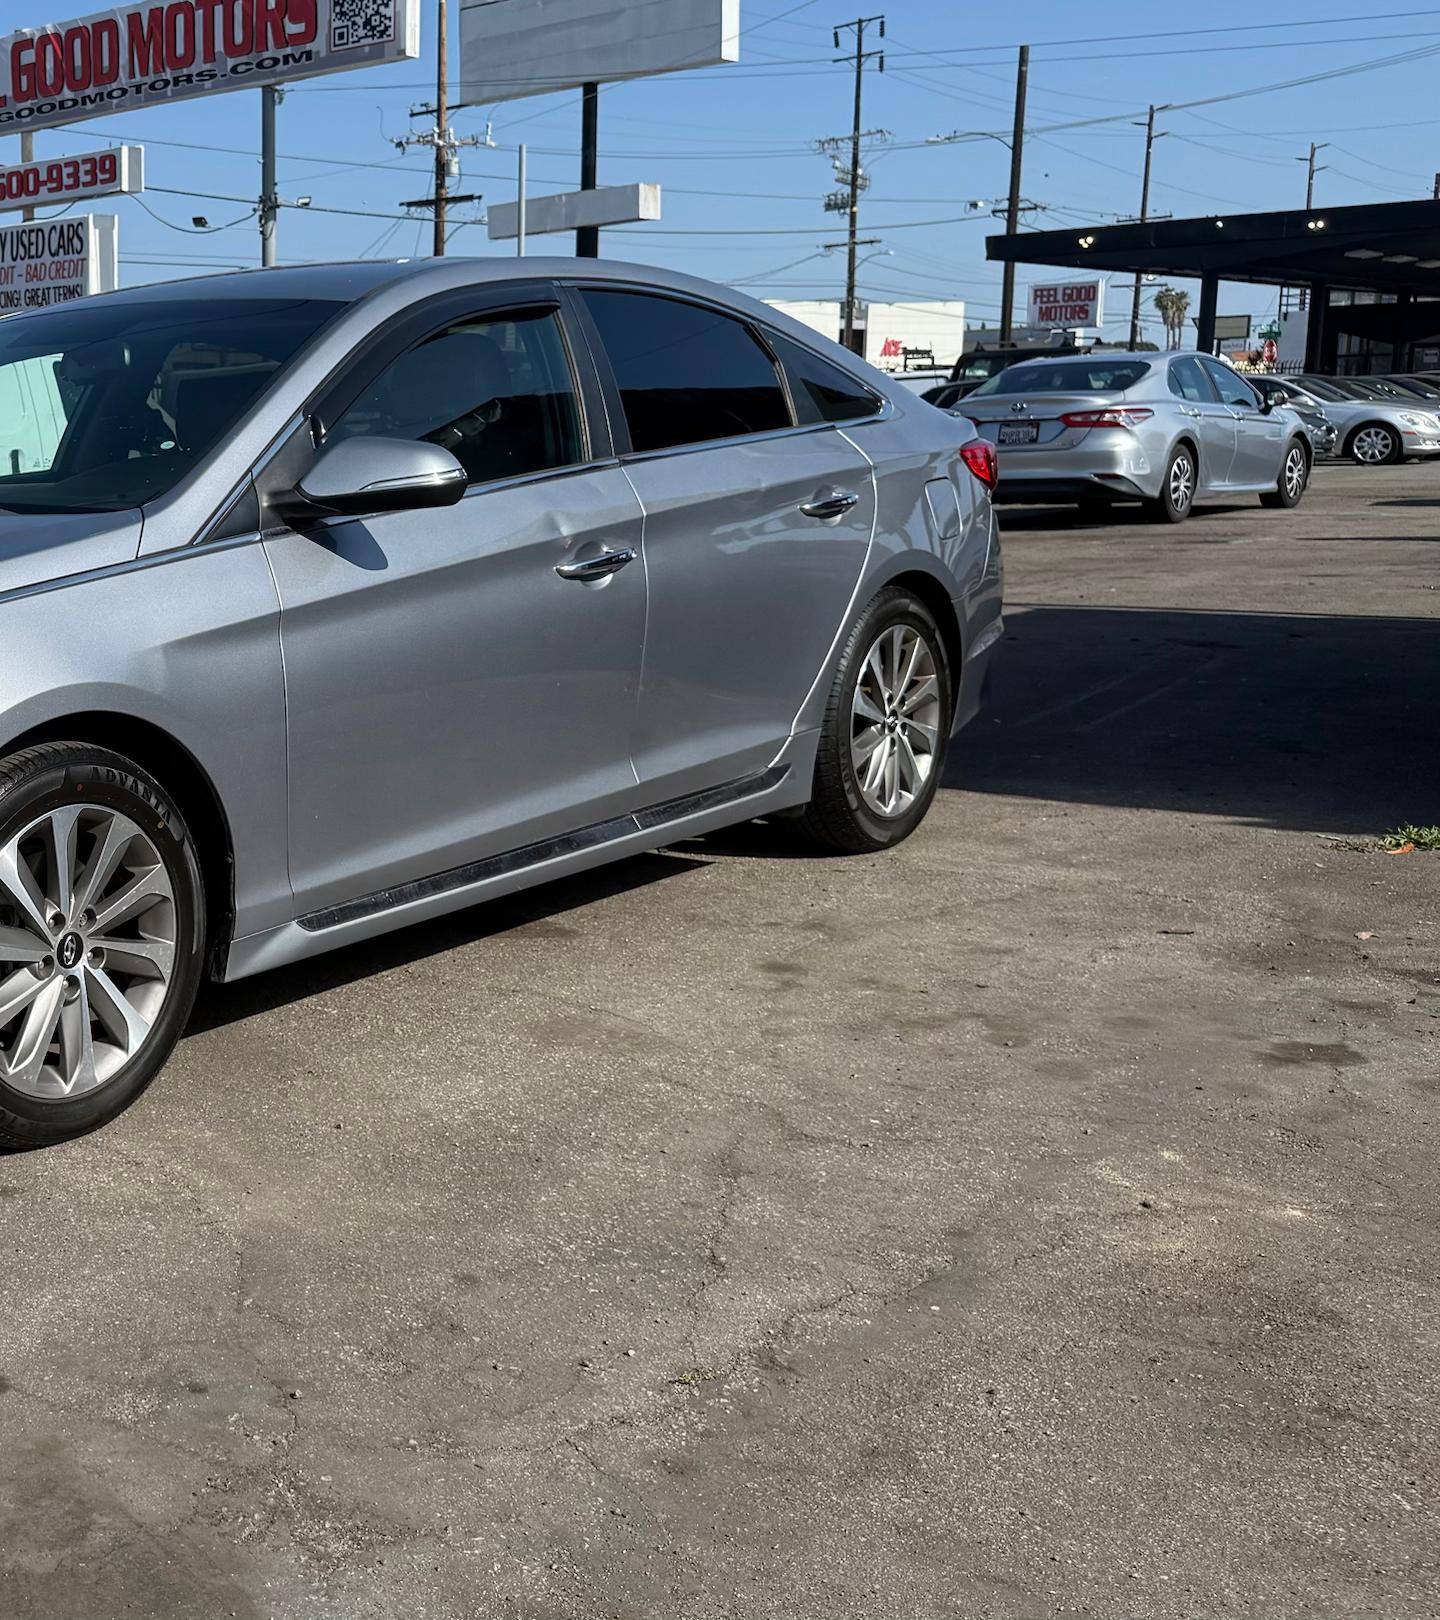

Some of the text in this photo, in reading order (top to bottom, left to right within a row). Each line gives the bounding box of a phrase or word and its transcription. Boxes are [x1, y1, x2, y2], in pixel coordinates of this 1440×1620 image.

[11, 18, 120, 103] GOOD
[126, 0, 318, 80] MOTORS
[9, 227, 45, 262] USED
[48, 221, 84, 256] CARS
[25, 262, 46, 283] BAD
[48, 258, 87, 280] CREDIT
[24, 286, 51, 307] GREAT
[52, 283, 83, 304] TERMS!
[1033, 285, 1096, 304] FEEL GOOD
[1038, 304, 1089, 322] MOTORS
[90, 766, 172, 824] ADVANTA
